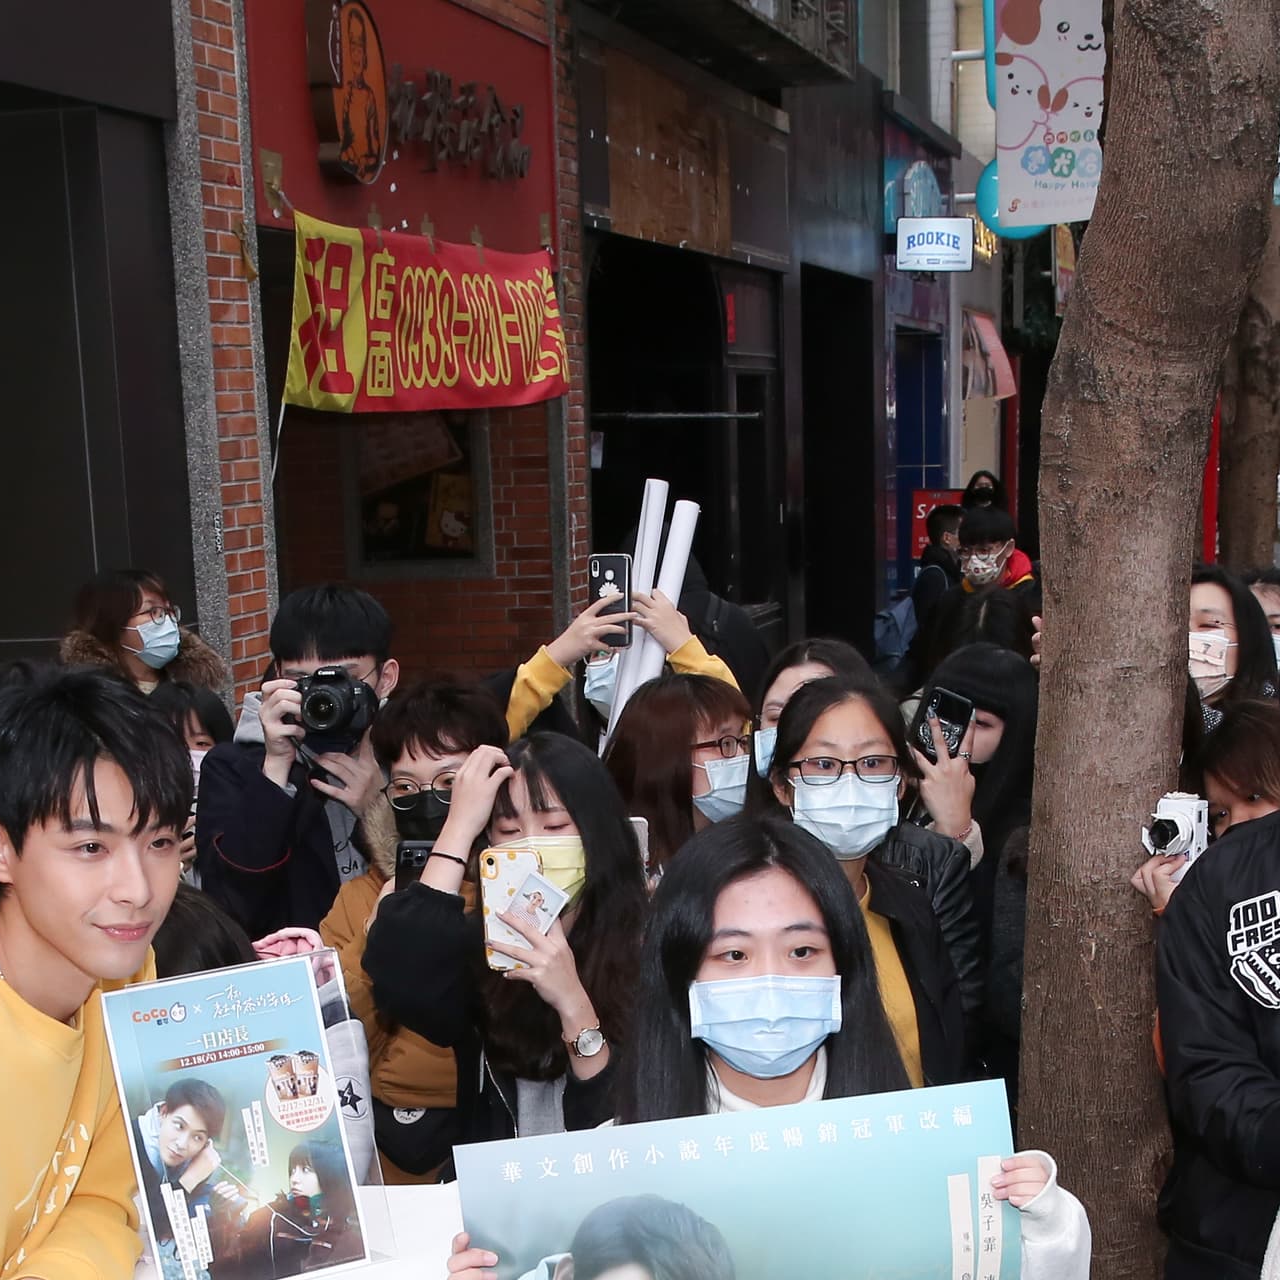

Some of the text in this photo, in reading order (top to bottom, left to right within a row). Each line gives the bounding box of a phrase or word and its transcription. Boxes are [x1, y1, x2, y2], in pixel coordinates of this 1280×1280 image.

[906, 232, 961, 250] ROOKIE
[366, 248, 396, 396] 店面
[131, 1006, 168, 1023] CoCo
[185, 1026, 250, 1050] 一日店長
[500, 1103, 975, 1184] 華文創作小說年度暢銷冠軍改編
[980, 1193, 997, 1252] 吳子霏
